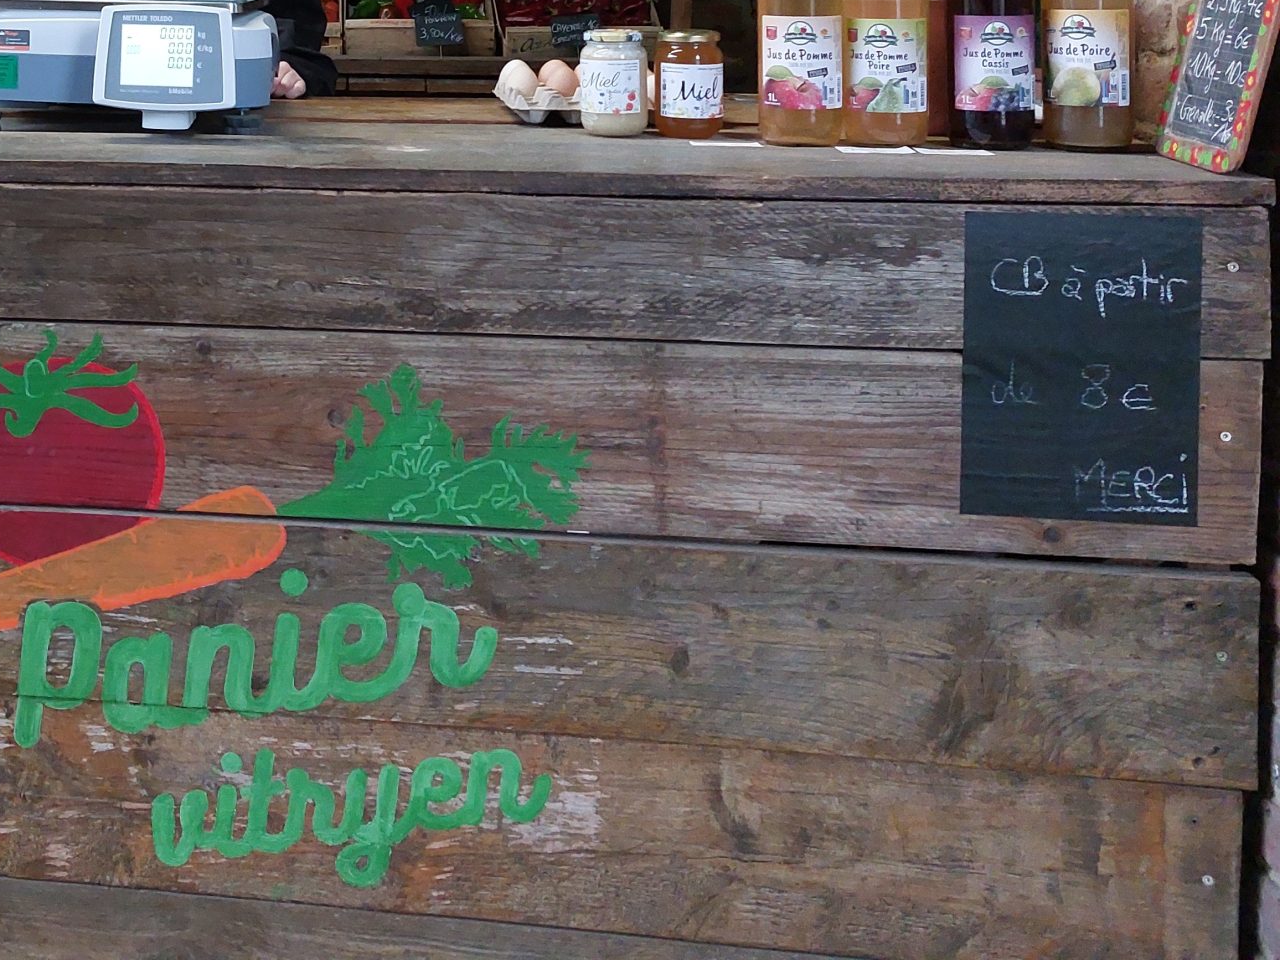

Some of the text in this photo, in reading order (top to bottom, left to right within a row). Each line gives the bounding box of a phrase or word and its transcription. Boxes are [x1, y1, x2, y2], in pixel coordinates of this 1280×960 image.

[197, 31, 206, 39] kg
[197, 45, 213, 53] €/kg
[767, 48, 833, 61] Jus de Pomme
[962, 47, 1024, 59] Jus de Pomme
[1048, 42, 1111, 56] Jus de Poire
[865, 50, 875, 60] de
[876, 51, 909, 61] Pomme
[868, 60, 891, 71] Poire
[982, 58, 1009, 68] Cassis
[581, 71, 621, 91] Miel
[673, 76, 718, 101] Miel
[767, 92, 778, 102] 1L
[961, 95, 972, 104] 1L
[991, 255, 1050, 297] CB
[1081, 363, 1111, 410] 8
[12, 567, 499, 750] Panier
[150, 748, 552, 889] vitryen
